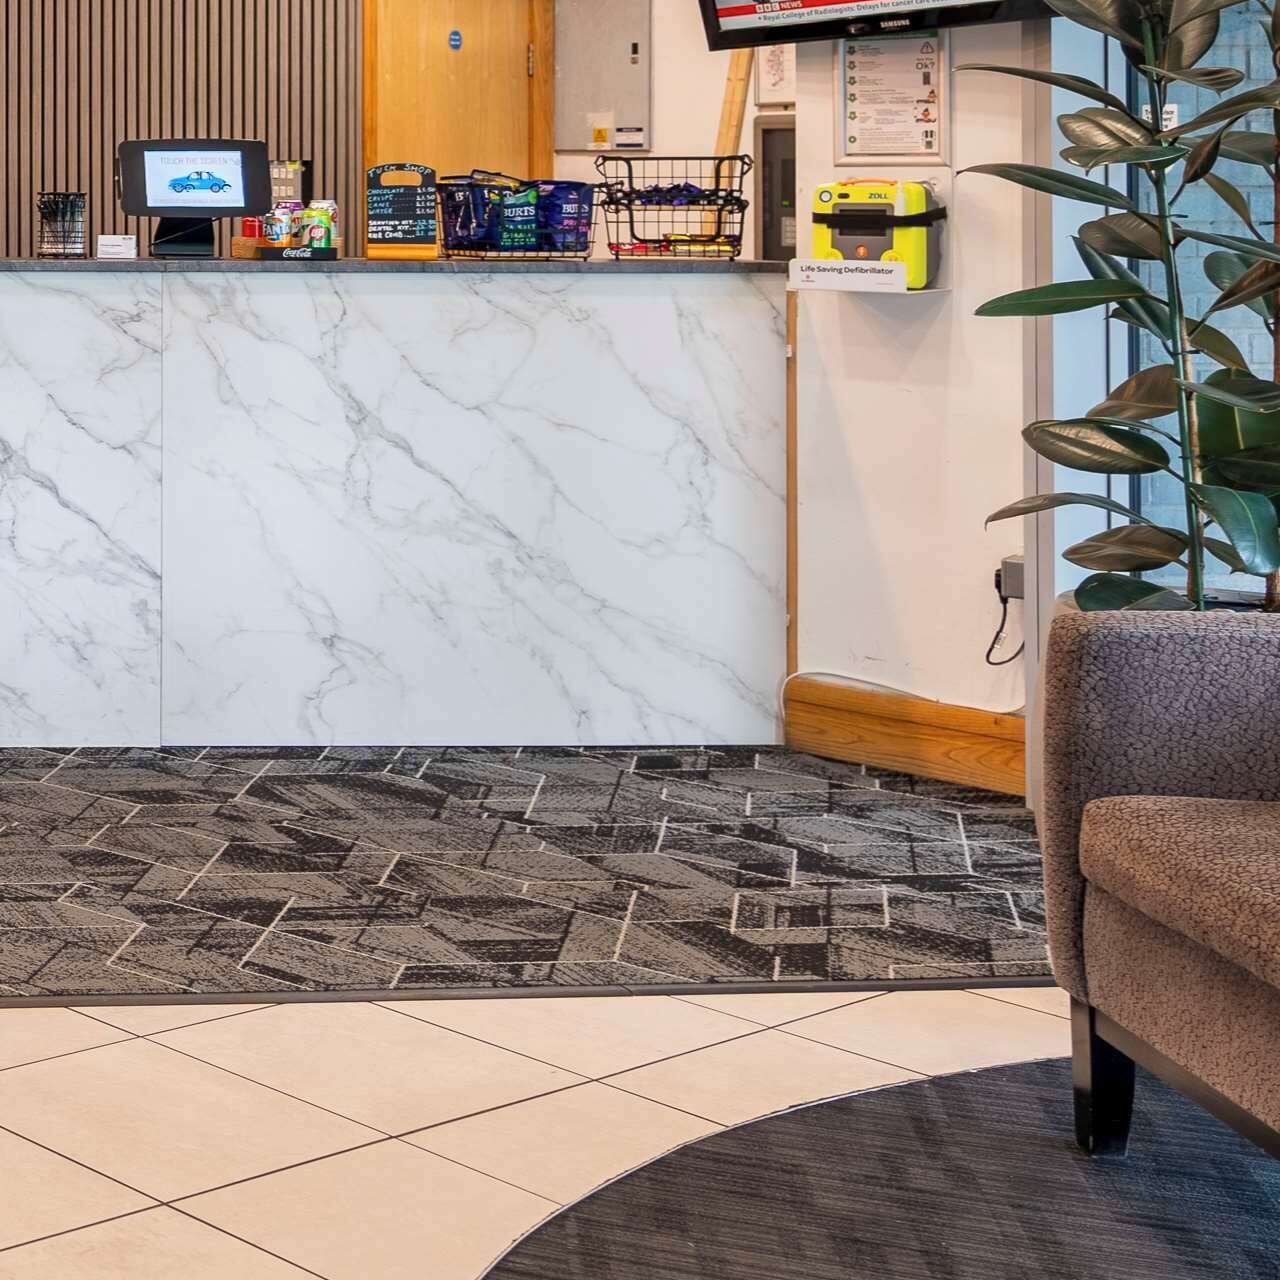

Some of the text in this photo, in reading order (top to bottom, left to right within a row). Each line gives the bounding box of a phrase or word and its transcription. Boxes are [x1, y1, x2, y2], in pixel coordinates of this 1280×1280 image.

[755, 0, 803, 13] BBC NEWS
[763, 14, 781, 22] Royal
[782, 10, 806, 19] College
[856, 2, 879, 11] Delays
[880, 19, 910, 28] SAMSUNG
[368, 163, 432, 178] TUCK SHOP
[868, 192, 888, 200] ZOLL
[816, 265, 843, 274] Saving
[843, 266, 894, 274] Defibrillator
